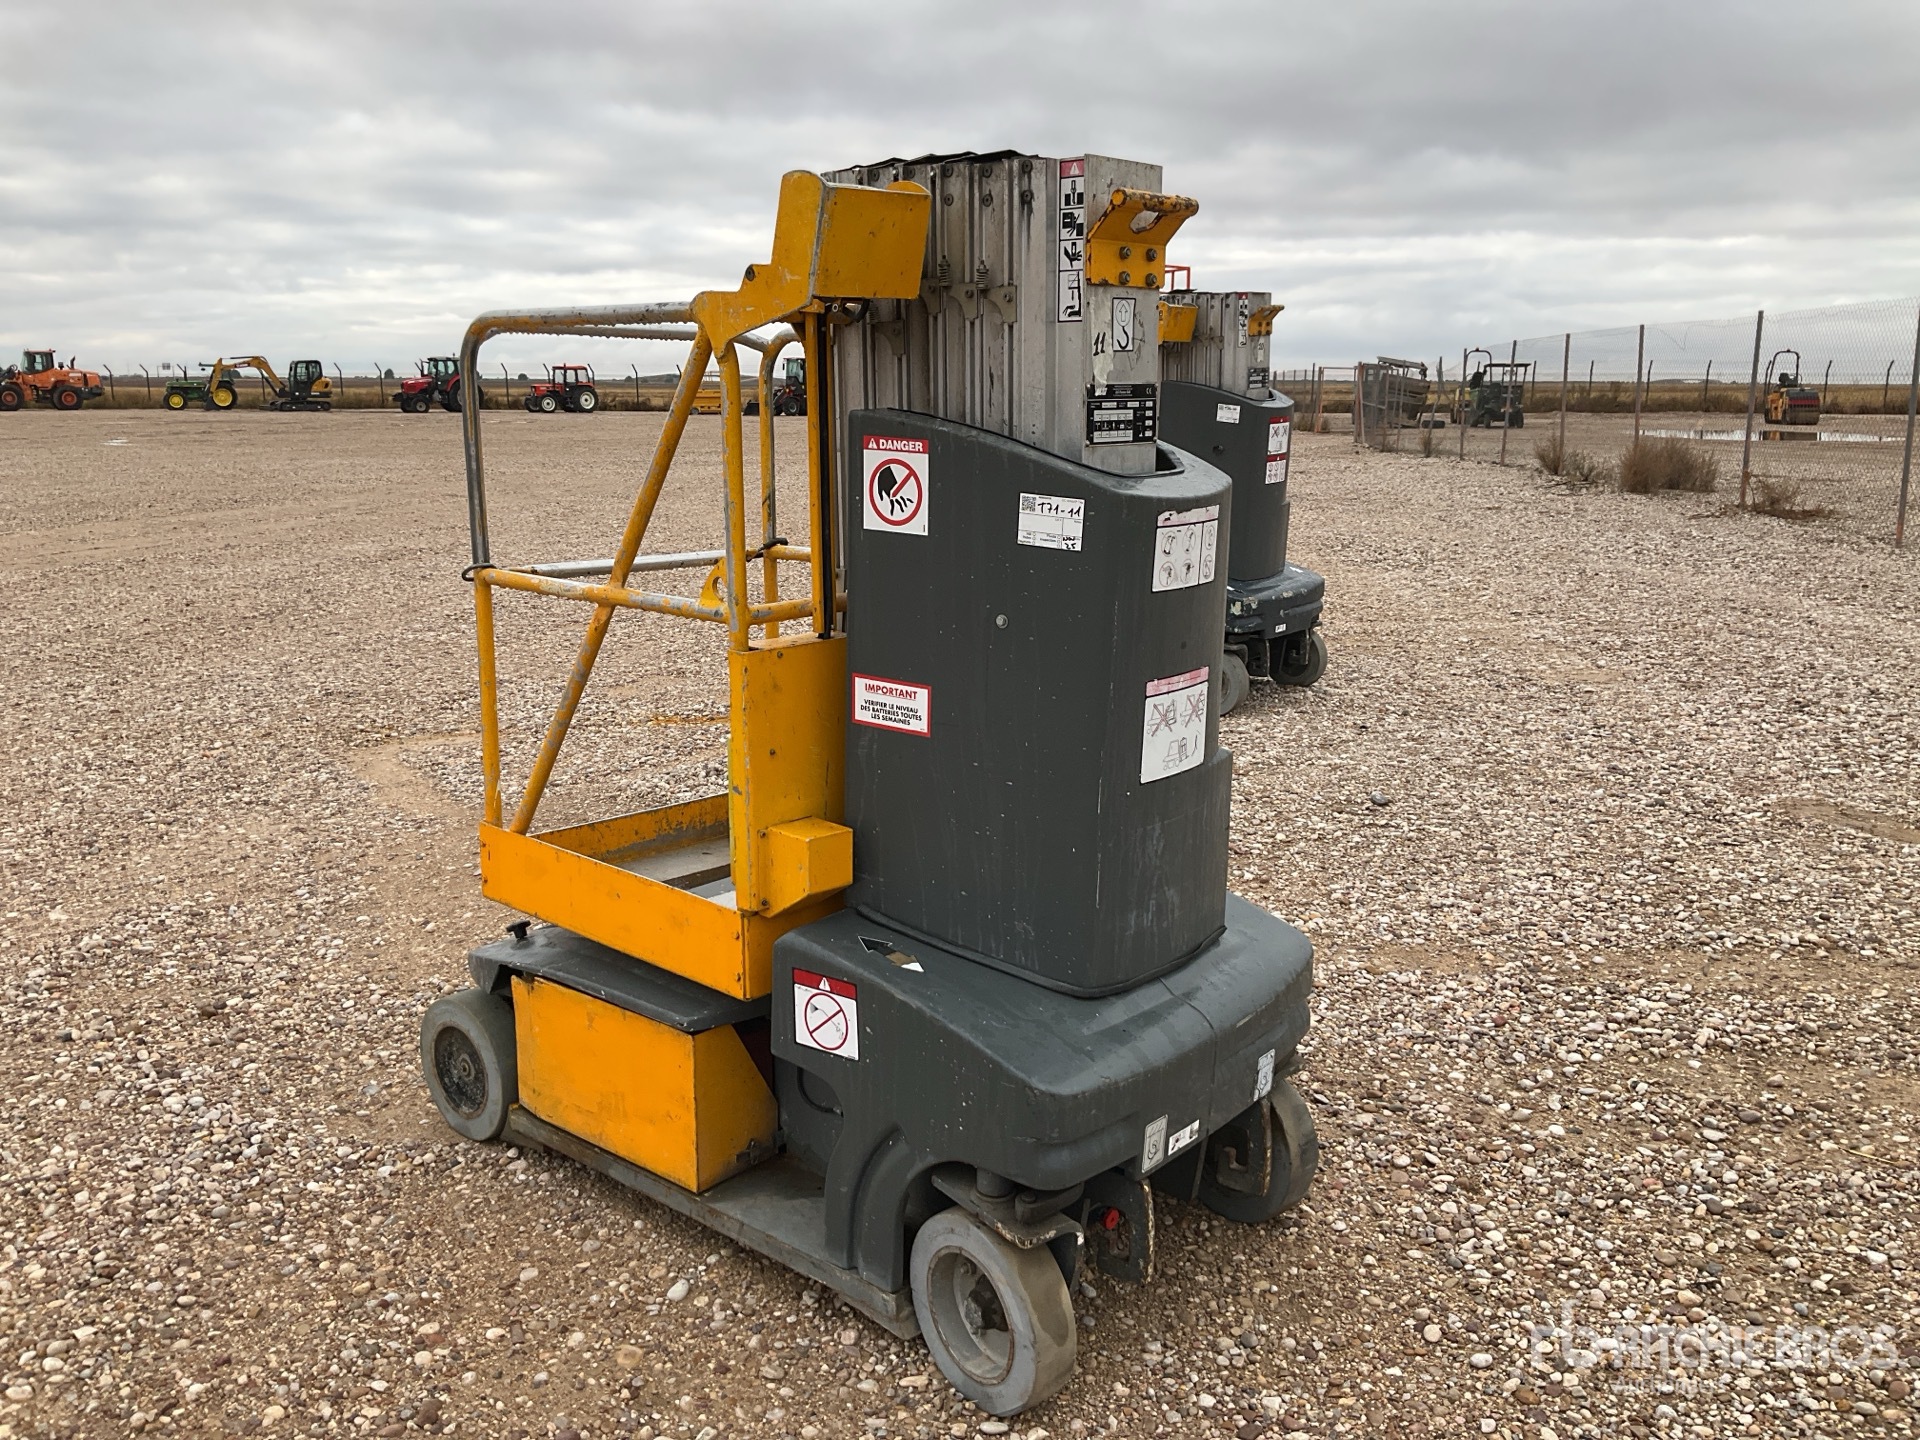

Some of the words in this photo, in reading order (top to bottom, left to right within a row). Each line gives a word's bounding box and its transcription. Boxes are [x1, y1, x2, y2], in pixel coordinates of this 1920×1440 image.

[1093, 331, 1106, 356] 11
[879, 438, 923, 452] DANGER
[865, 683, 917, 700] IMPORTANT
[864, 699, 887, 709] VERIFIER
[896, 705, 919, 714] NIVEAU
[872, 706, 899, 717] BATTERIES
[901, 712, 922, 721] TOUTES
[882, 714, 911, 725] SEMAINES
